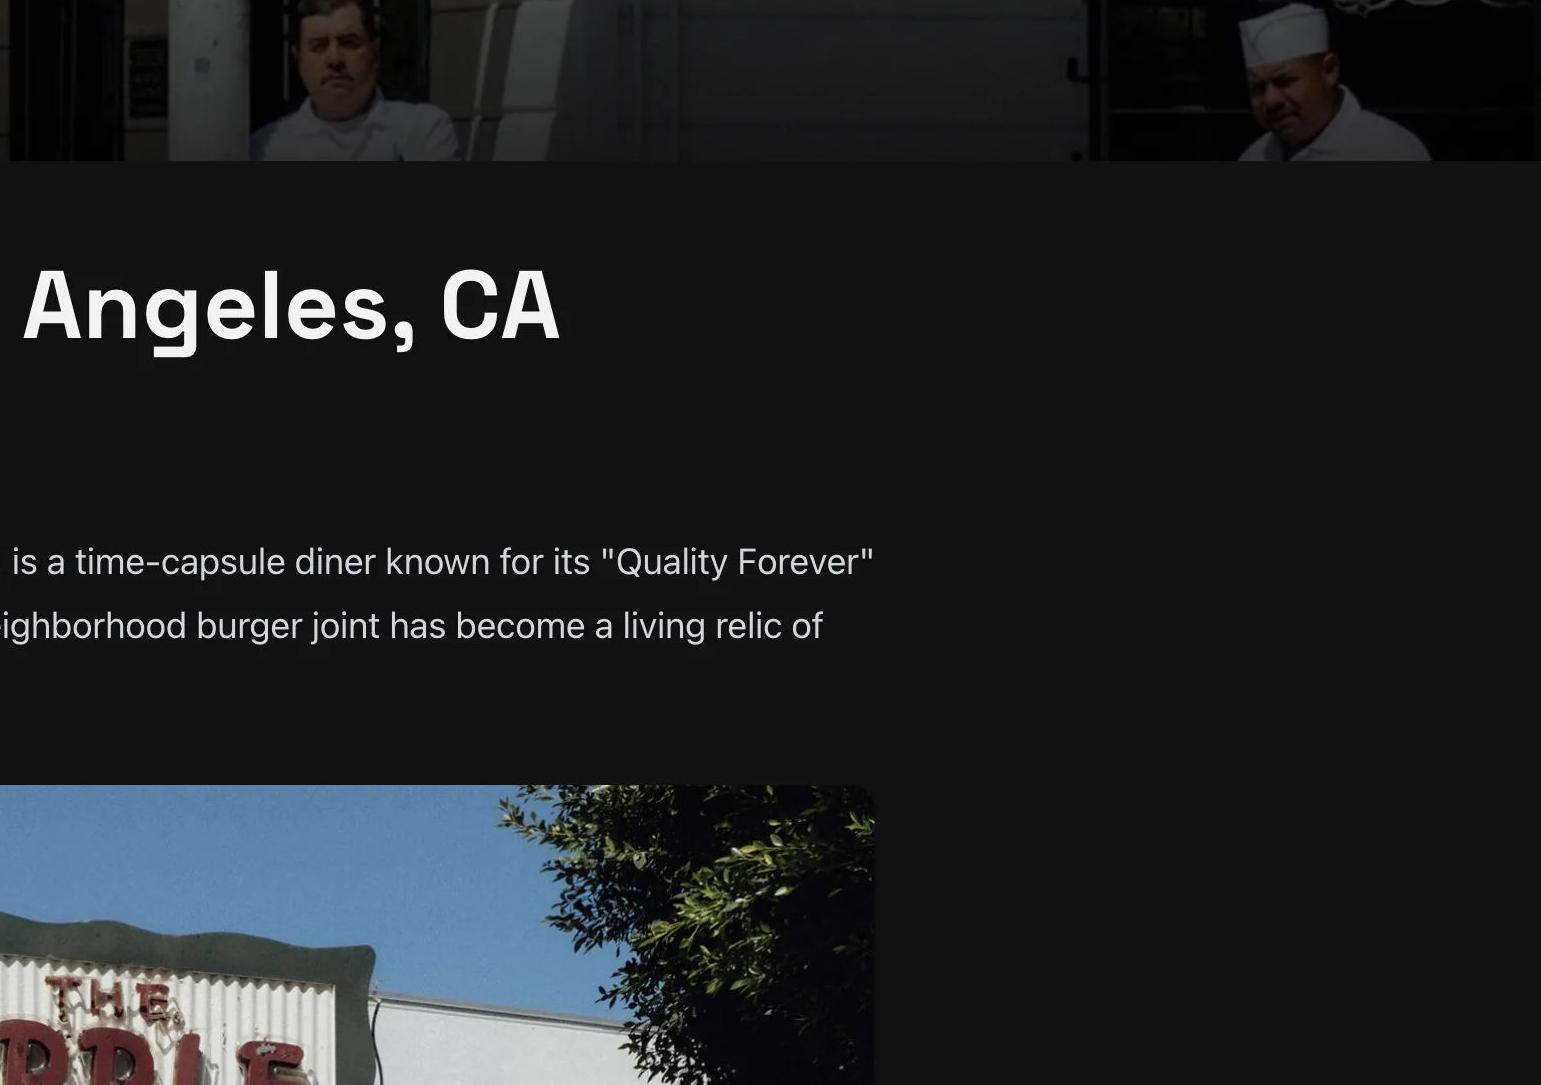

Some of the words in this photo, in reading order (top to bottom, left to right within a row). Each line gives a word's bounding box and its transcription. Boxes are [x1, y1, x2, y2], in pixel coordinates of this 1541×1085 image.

[24, 270, 414, 358] Angeles,
[443, 268, 560, 340] CA
[13, 546, 37, 575] is
[47, 554, 65, 575] a
[74, 546, 286, 581] time-capsule
[295, 546, 377, 575] diner
[387, 546, 489, 575] known
[499, 546, 545, 575] for
[554, 546, 590, 575] its
[602, 546, 729, 582] "Quality
[739, 547, 873, 575] Forever"
[198, 610, 304, 646] burger
[310, 610, 380, 646] joint
[391, 610, 446, 639] has
[457, 610, 585, 639] become
[595, 618, 613, 639] a
[624, 610, 705, 646] living
[717, 610, 782, 639] relic
[792, 610, 824, 639] of
[45, 975, 170, 1022] THE
